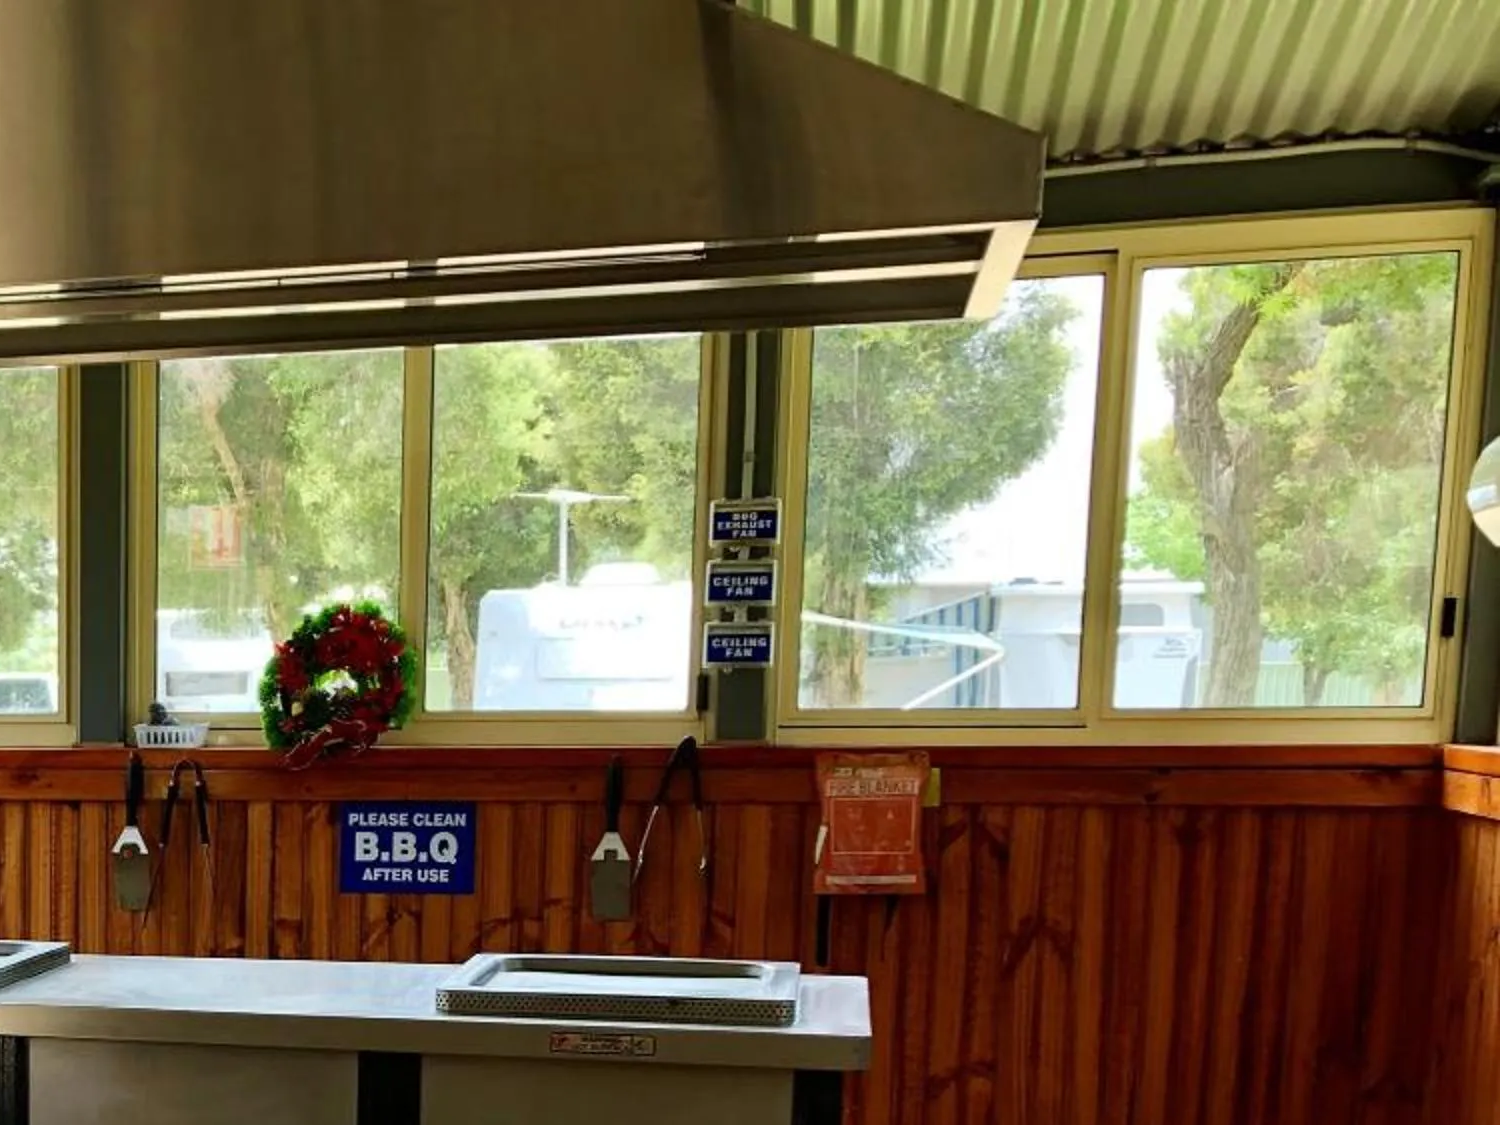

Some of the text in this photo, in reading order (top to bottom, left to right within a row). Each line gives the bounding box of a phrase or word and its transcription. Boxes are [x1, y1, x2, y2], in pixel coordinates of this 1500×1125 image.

[717, 519, 772, 531] EXHAUST
[732, 529, 757, 538] FAN
[712, 575, 769, 587] CEILING
[726, 587, 753, 596] FAN
[711, 637, 767, 648] CEILING
[725, 647, 753, 657] FAN
[348, 813, 467, 827] PLEASE CLEAN
[354, 831, 459, 865] B.B.Q
[362, 867, 449, 883] AFTER USE
